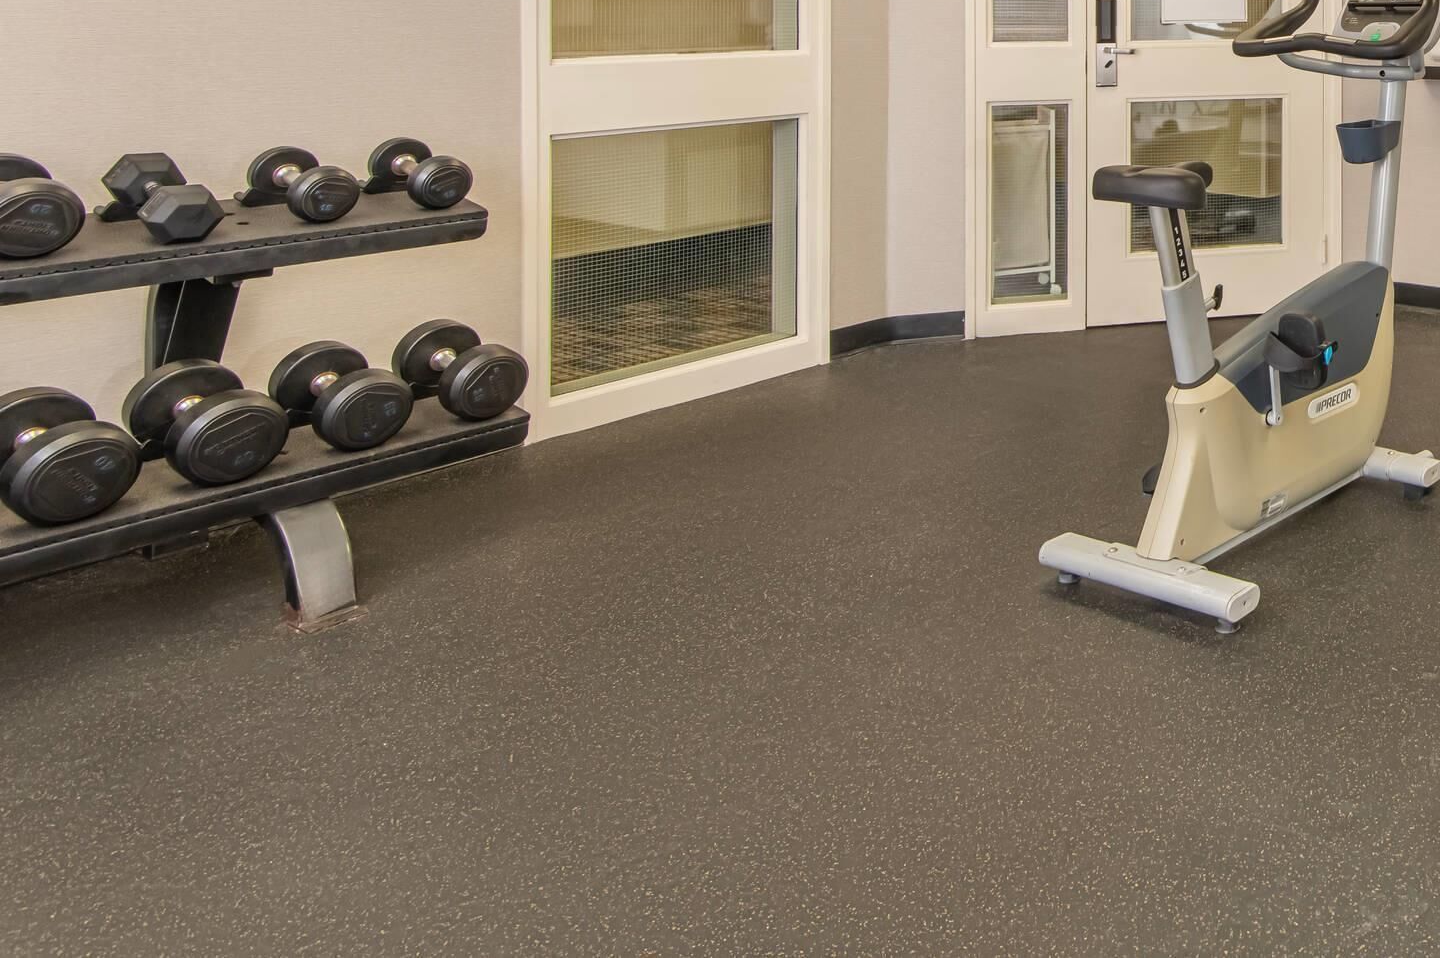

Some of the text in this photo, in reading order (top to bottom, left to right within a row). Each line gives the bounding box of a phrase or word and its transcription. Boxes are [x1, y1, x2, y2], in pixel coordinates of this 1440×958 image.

[1174, 226, 1179, 234] 1
[1175, 238, 1181, 246] 2
[1181, 259, 1185, 267] 4
[1319, 388, 1352, 411] PRECOR
